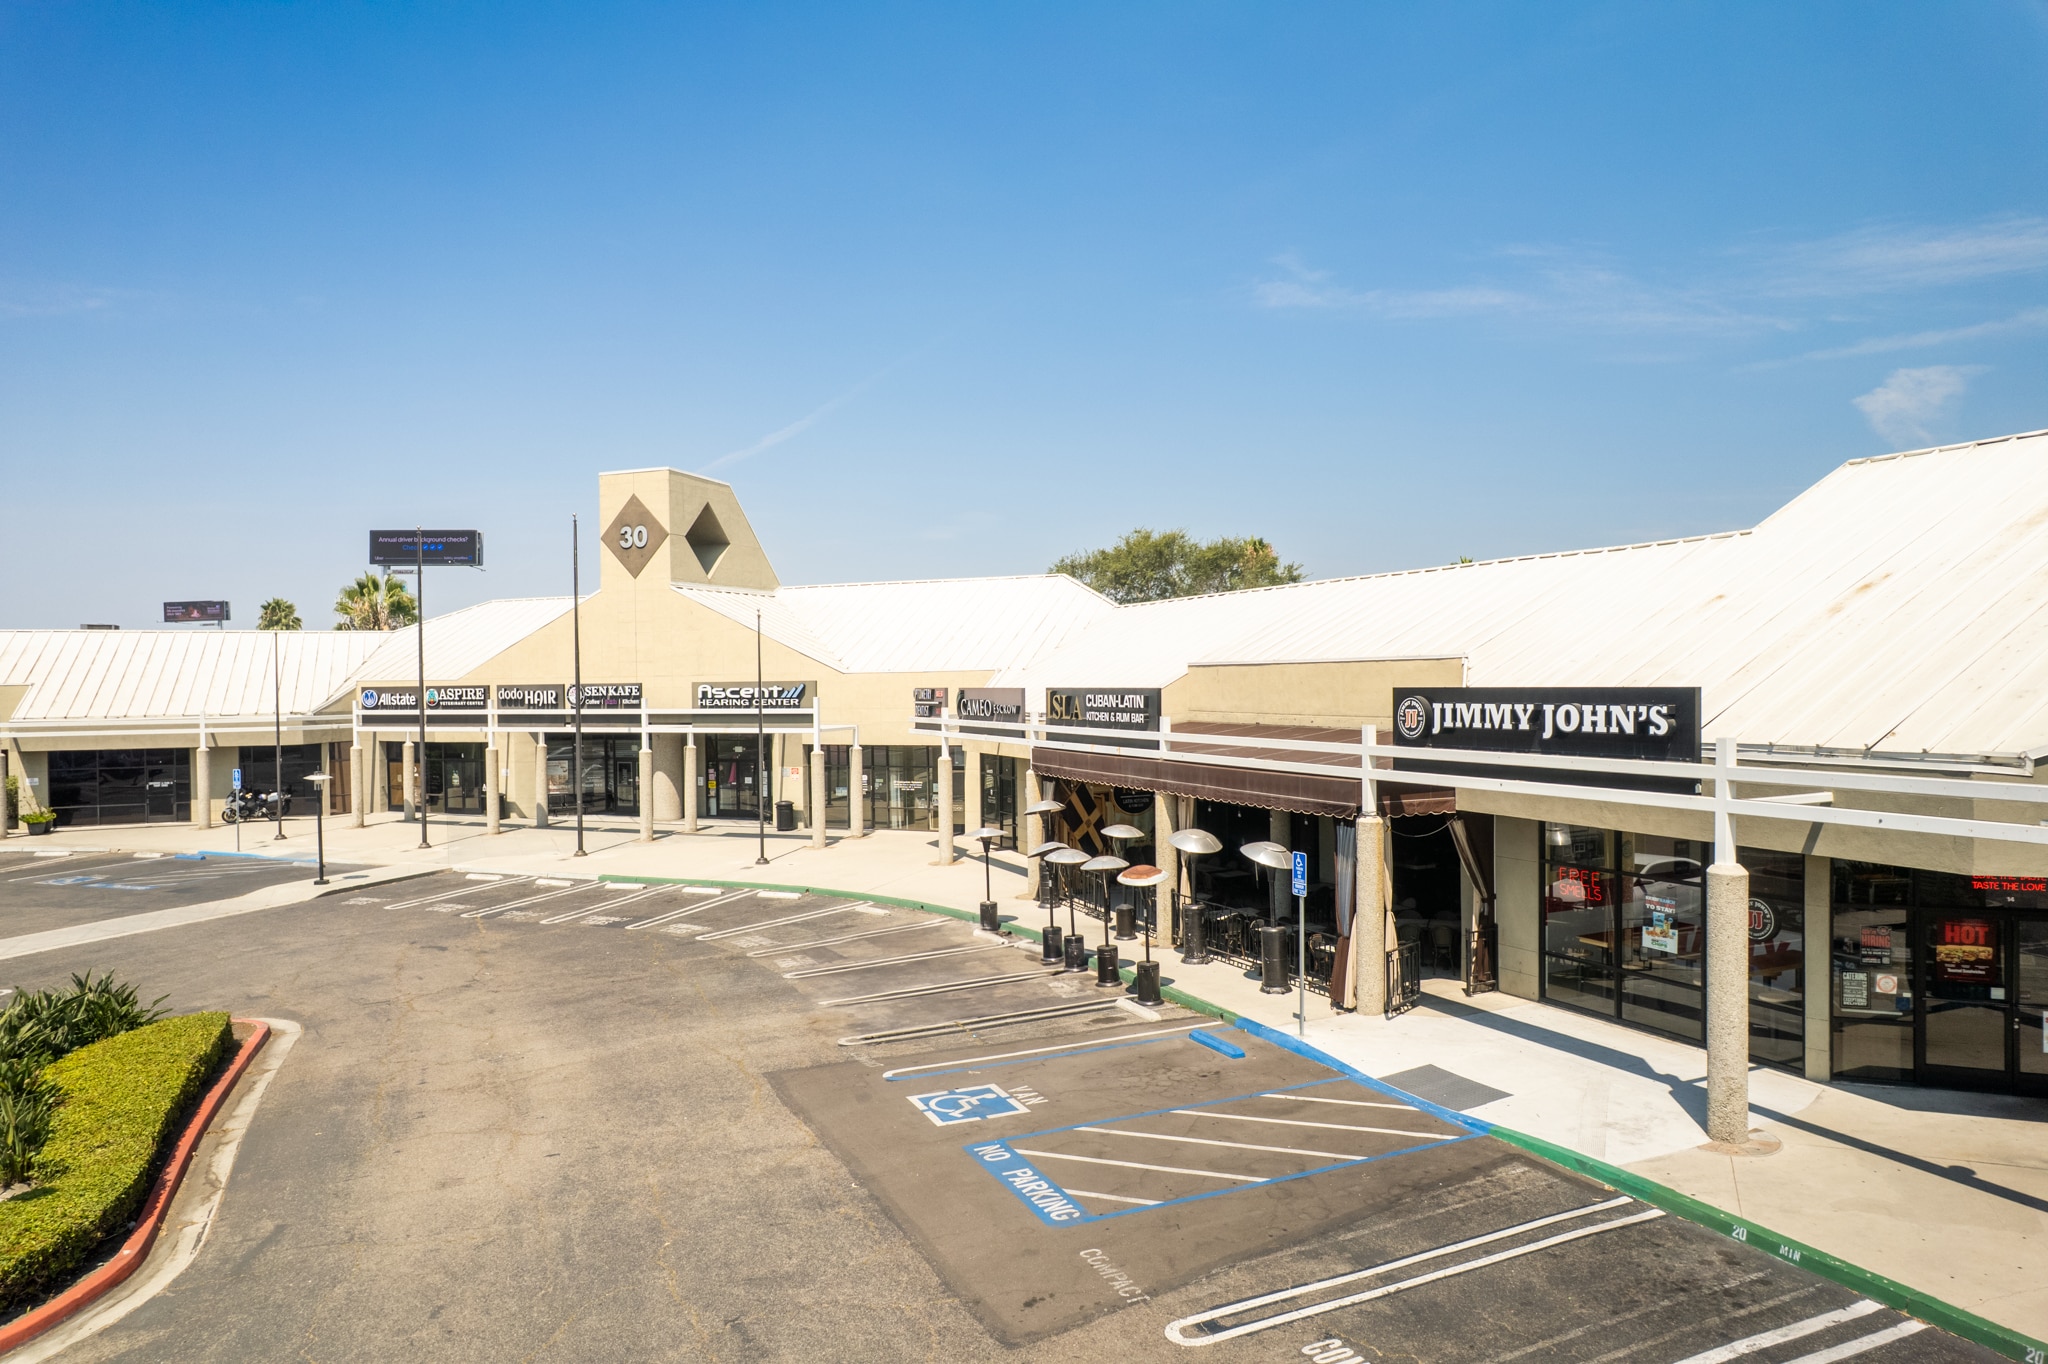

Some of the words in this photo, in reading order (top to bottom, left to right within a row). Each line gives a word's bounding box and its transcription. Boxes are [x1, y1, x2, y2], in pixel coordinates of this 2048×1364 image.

[619, 525, 648, 549] 30
[378, 692, 416, 706] Allstate
[438, 688, 484, 700] ASPIRE
[498, 688, 523, 700] dodo
[524, 690, 556, 706] HAIR
[584, 686, 607, 696] SEN
[608, 686, 640, 696] KAFE
[698, 684, 782, 698] Ascent
[960, 698, 992, 716] CAMEO
[993, 704, 1016, 714] ESCROW
[1046, 689, 1083, 720] ISLA
[1086, 694, 1144, 708] CUBAN-LATIN
[1086, 711, 1110, 722] KITCHEN
[1110, 712, 1115, 722] &
[1116, 712, 1130, 722] RUM
[1131, 712, 1144, 724] BAR
[1405, 708, 1418, 728] JJ
[1432, 702, 1534, 734] JIMMY
[1542, 704, 1668, 740] JOHN'S
[1558, 866, 1600, 889] FREE
[1972, 881, 1999, 890] TASTE
[2001, 882, 2019, 890] THE
[2021, 883, 2047, 892] LOVE
[1560, 884, 1602, 901] SMELLS
[1656, 905, 1676, 914] STAY!
[1861, 935, 1891, 948] HIRING
[1944, 924, 1988, 945] HOT
[1843, 972, 1867, 980] CATERING
[1008, 1085, 1049, 1106] VAN
[974, 1144, 1011, 1162] NO
[1002, 1168, 1081, 1221] PARKING
[1732, 1224, 1747, 1241] 20
[1780, 1244, 1801, 1262] MIN
[1080, 1248, 1150, 1304] COMPACT
[1301, 1339, 1371, 1364] CO
[2025, 1347, 2044, 1364] 20
